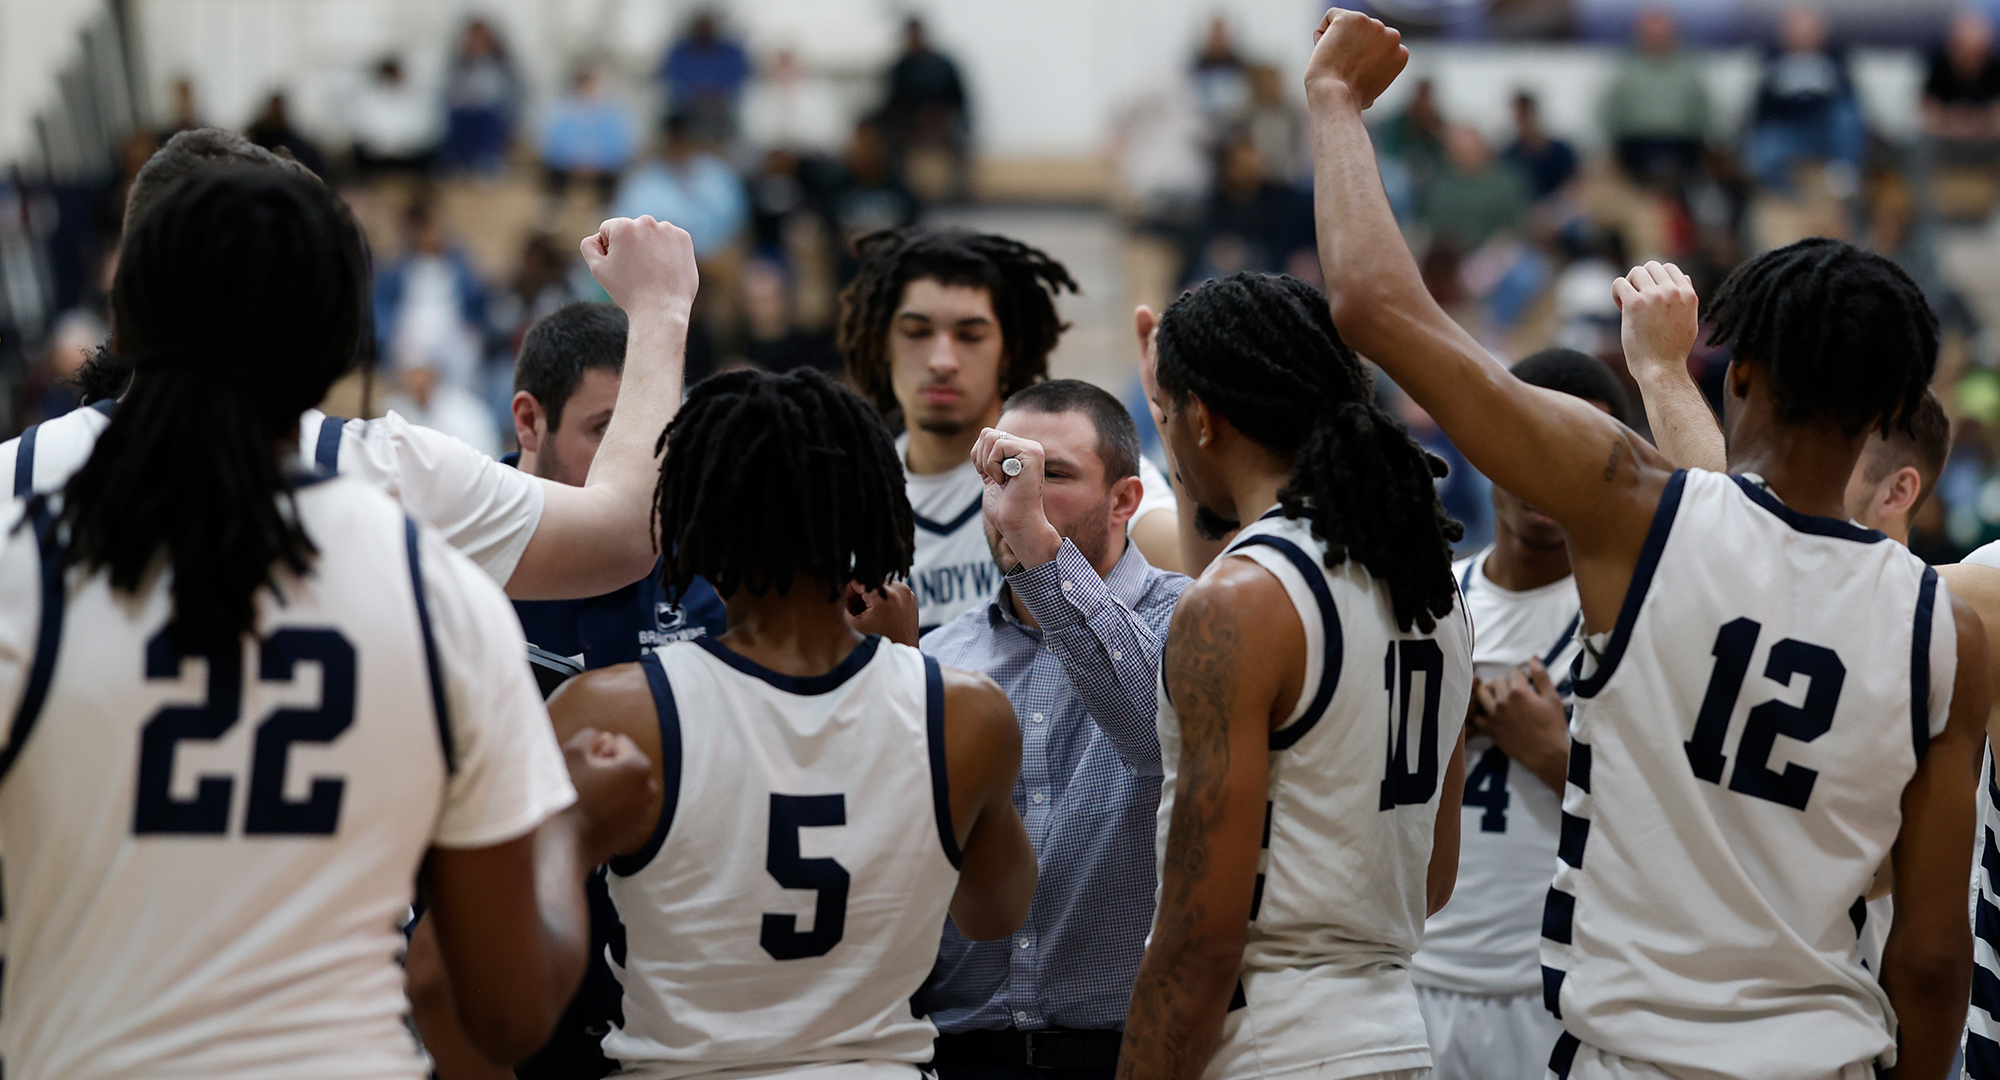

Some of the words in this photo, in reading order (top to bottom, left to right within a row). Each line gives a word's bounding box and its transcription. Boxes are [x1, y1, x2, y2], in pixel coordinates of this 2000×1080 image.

[132, 625, 359, 837] 22
[1379, 639, 1444, 811] 10
[1683, 616, 1847, 812] 12
[760, 792, 850, 960] 5
